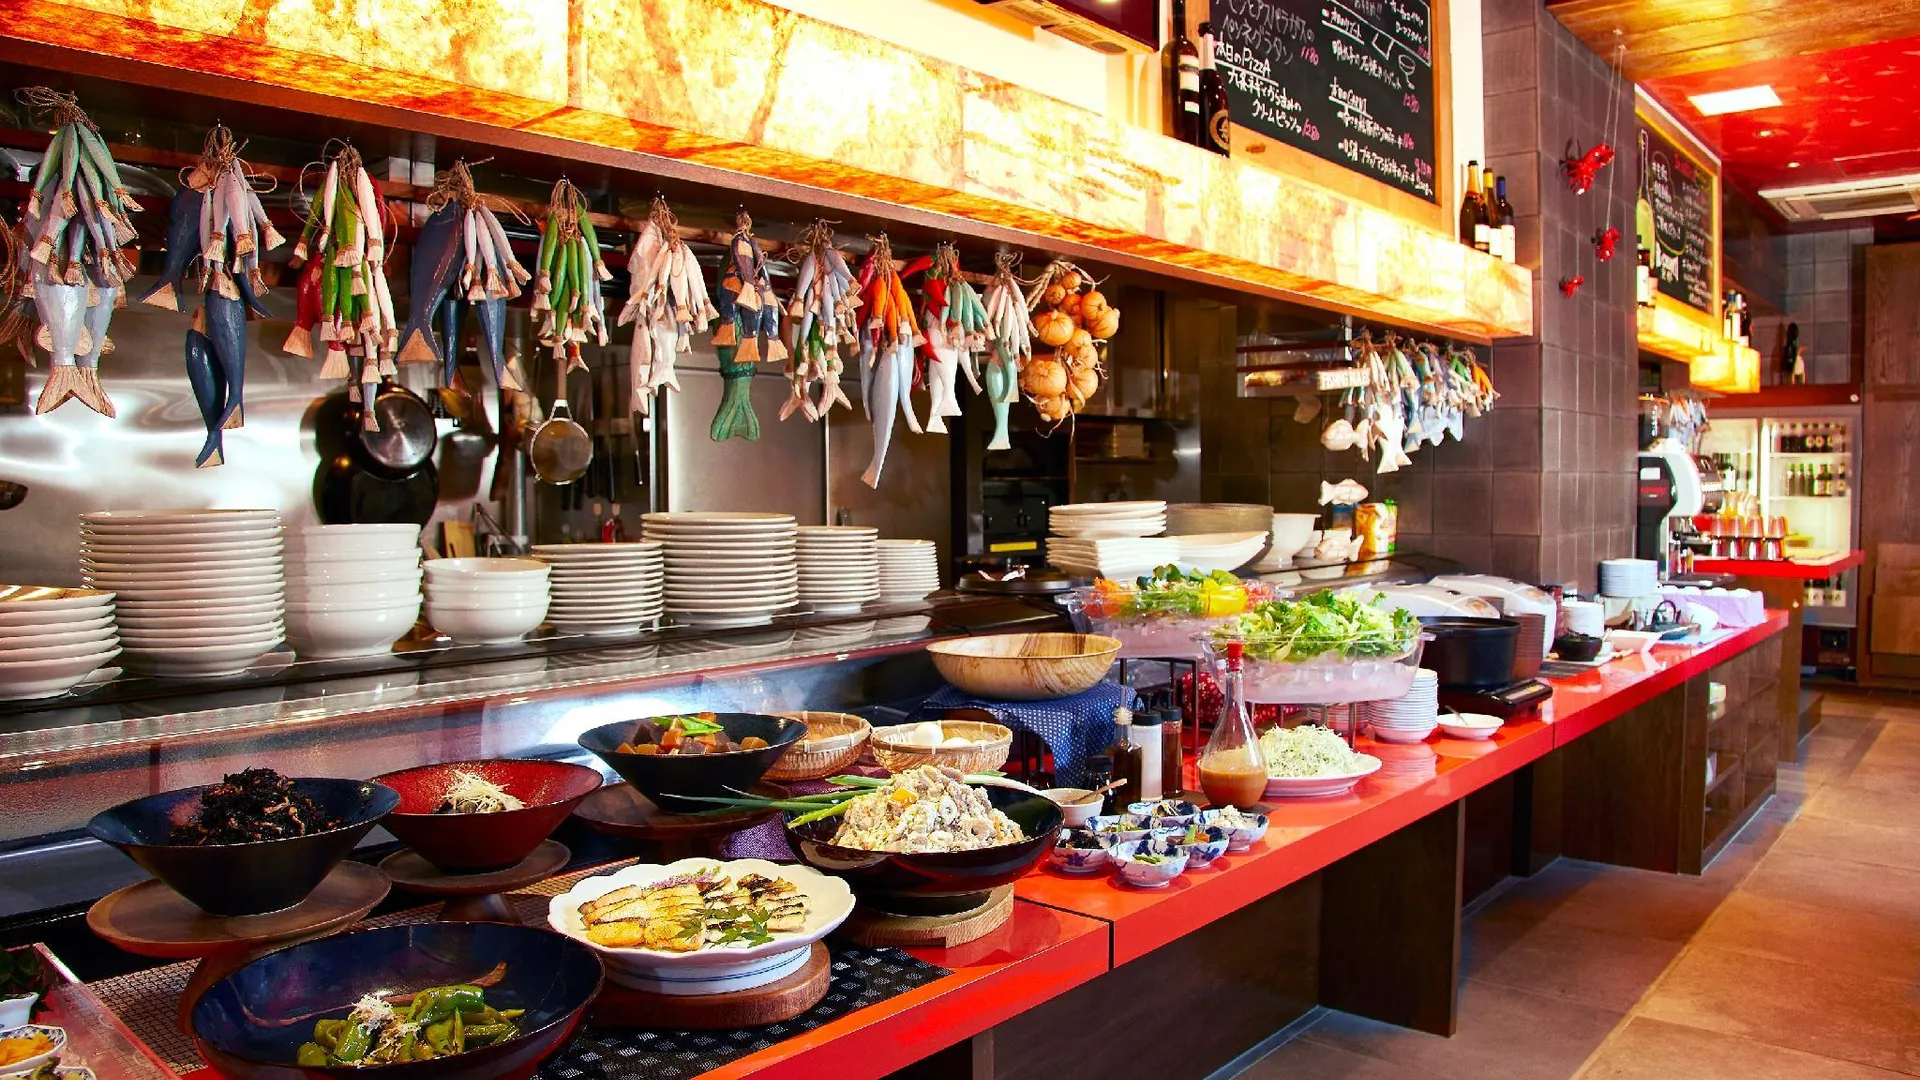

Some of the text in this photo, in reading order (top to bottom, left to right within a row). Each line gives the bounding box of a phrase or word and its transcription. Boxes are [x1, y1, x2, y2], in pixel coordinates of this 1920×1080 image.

[1222, 14, 1294, 65] ペンネグラタン
